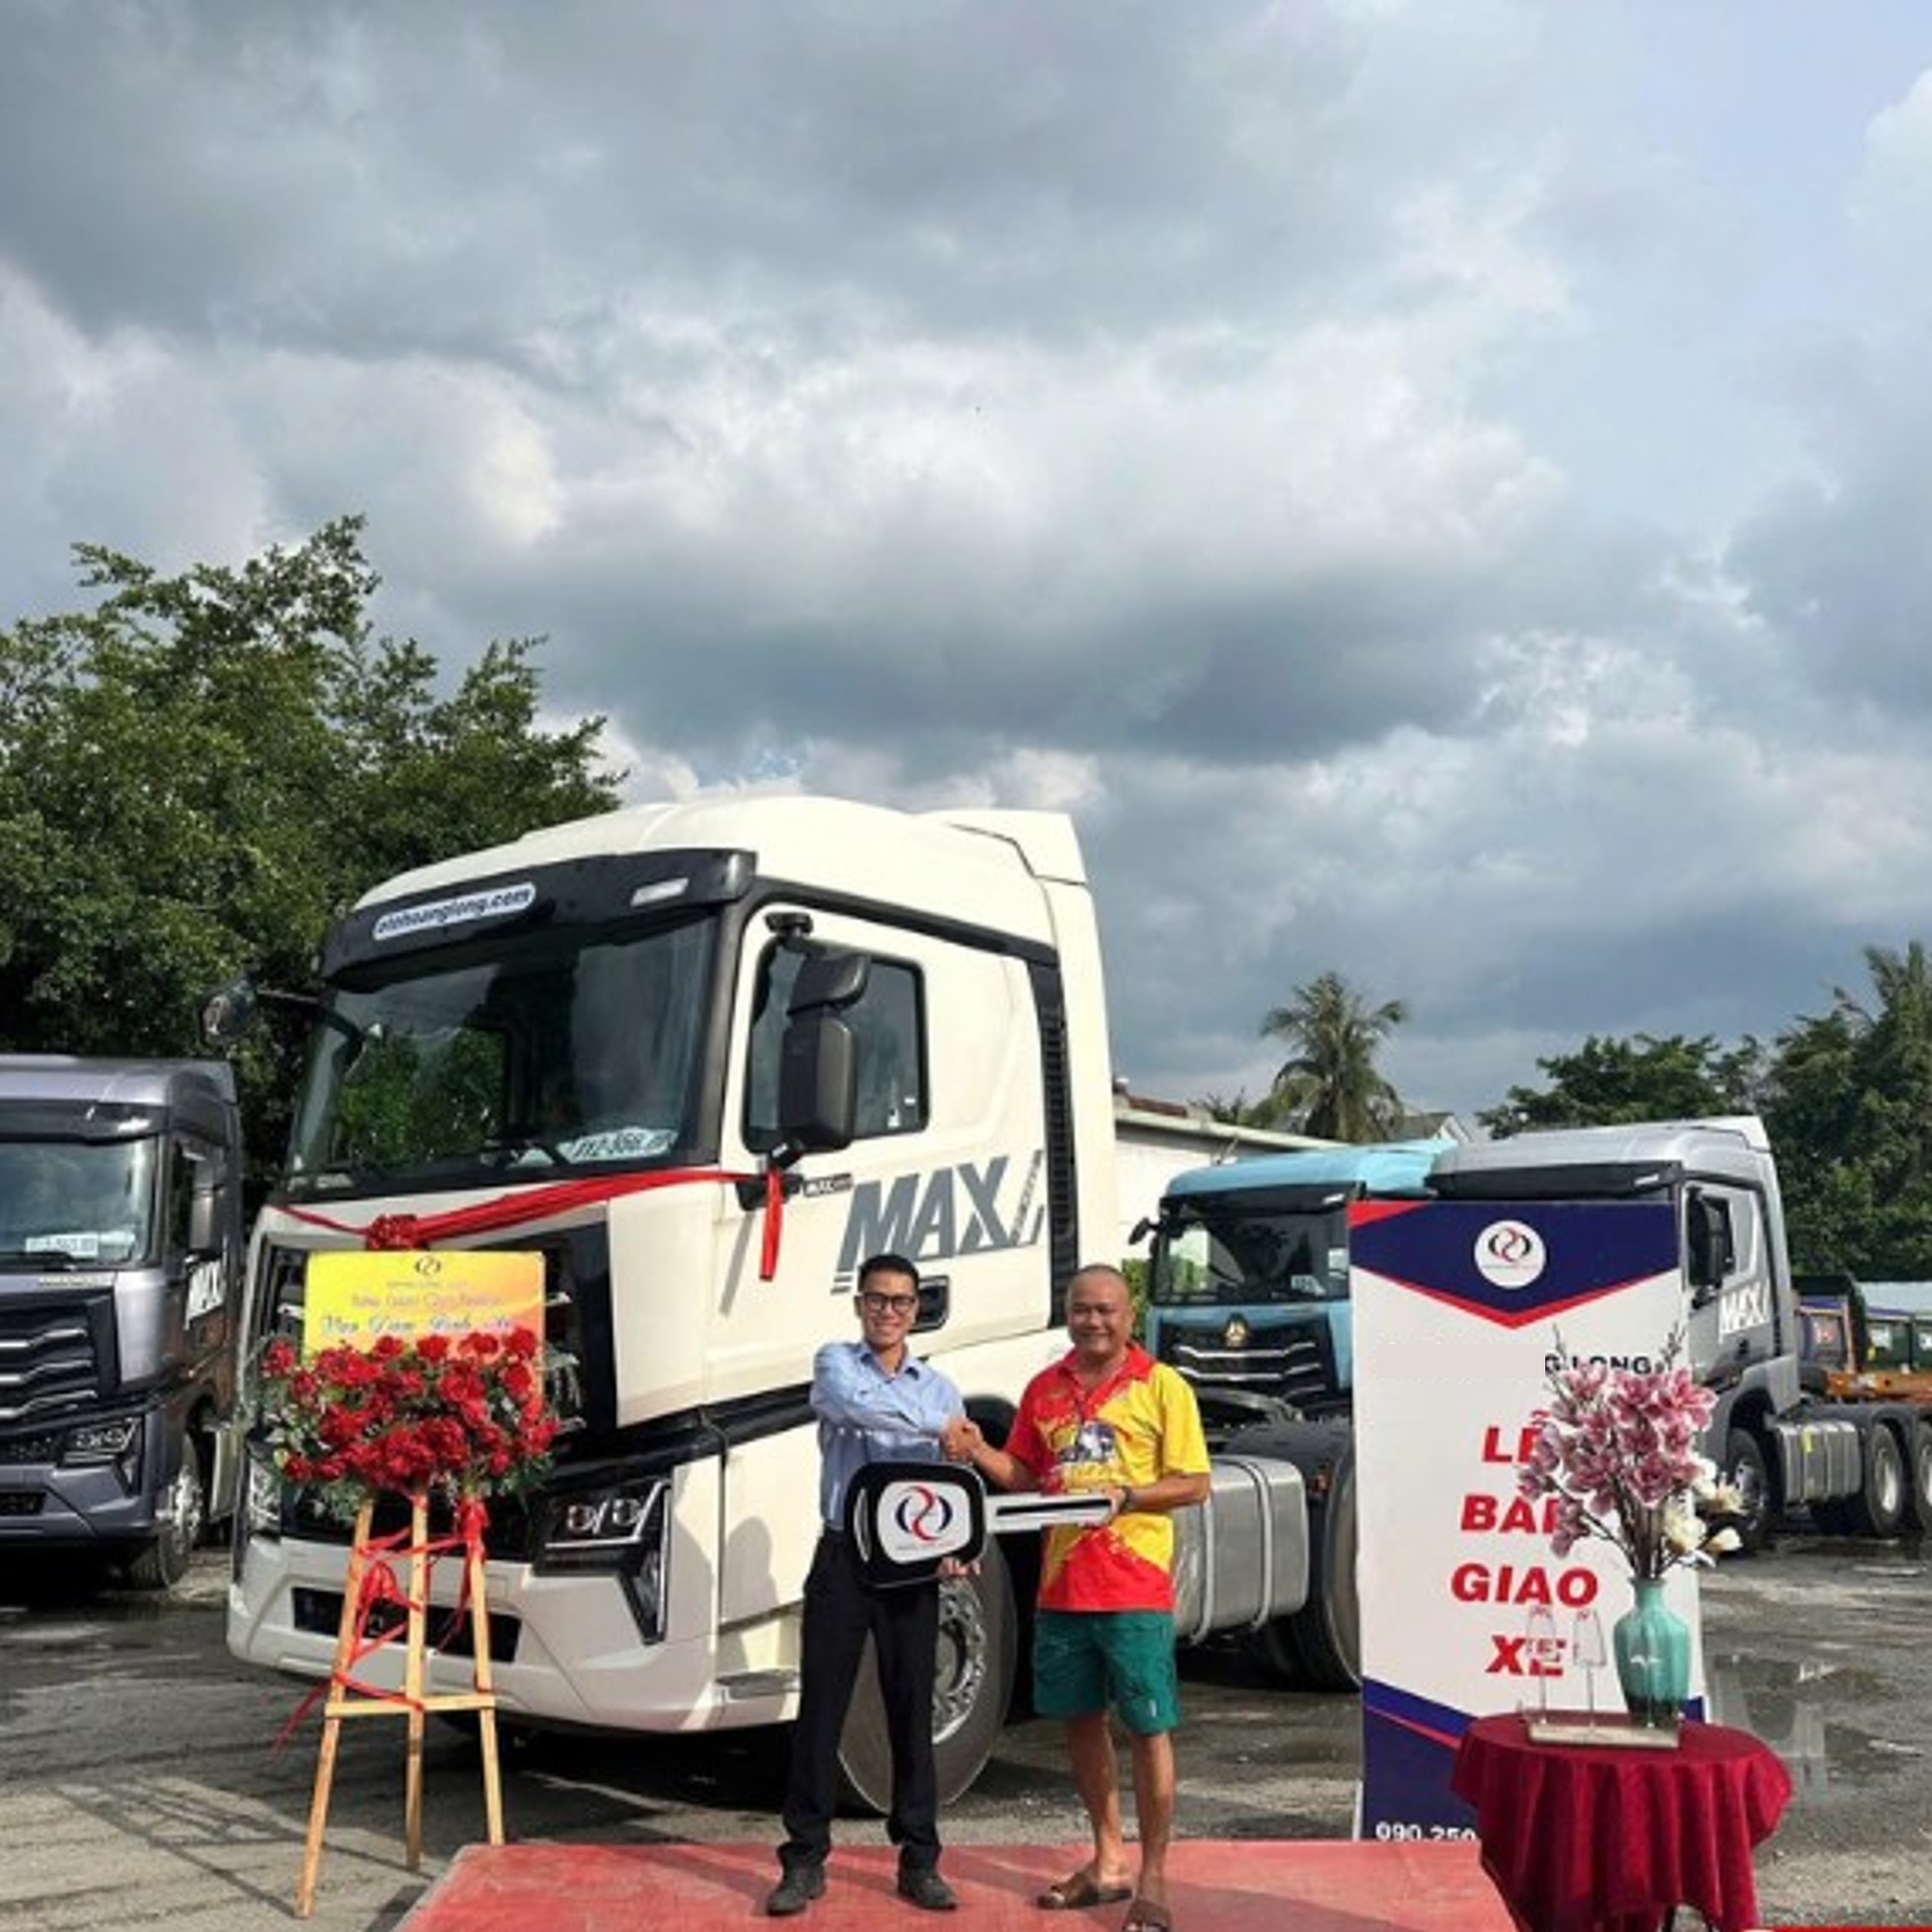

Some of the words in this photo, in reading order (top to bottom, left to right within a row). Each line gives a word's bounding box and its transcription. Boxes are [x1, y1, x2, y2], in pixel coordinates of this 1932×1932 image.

[837, 1155, 1010, 1272] MAX
[1450, 1563, 1598, 1608] GIAO
[1485, 1634, 1567, 1676] XE
